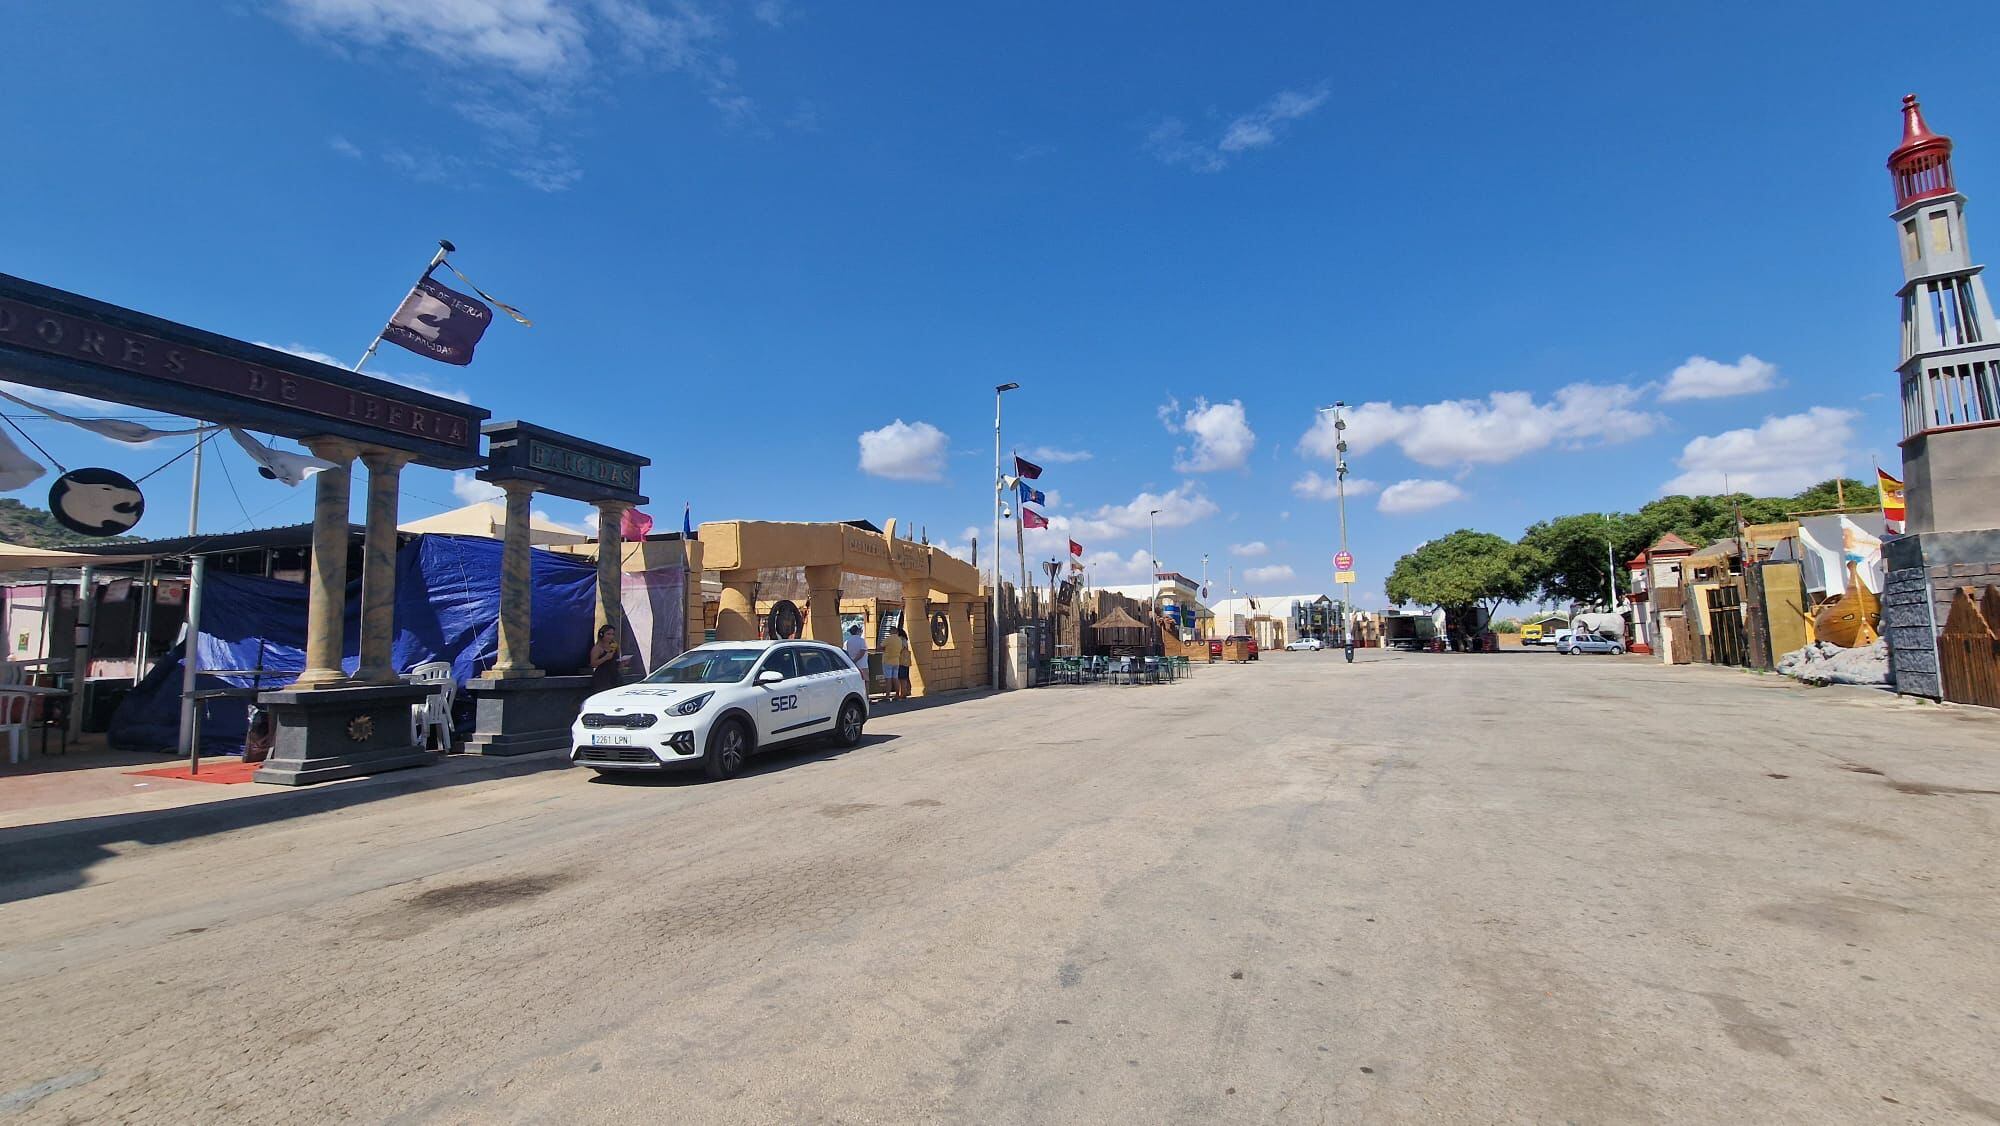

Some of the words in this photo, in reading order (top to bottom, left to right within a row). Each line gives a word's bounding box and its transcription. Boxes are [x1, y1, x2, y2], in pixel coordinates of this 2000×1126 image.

[452, 298, 484, 319] IBERIA
[248, 369, 299, 401] DE
[346, 395, 465, 440] IBERIA
[535, 446, 632, 483] BARCIDAS
[617, 688, 678, 697] SER
[771, 694, 798, 713] SER
[596, 735, 611, 745] 2261
[614, 735, 628, 745] LPN
